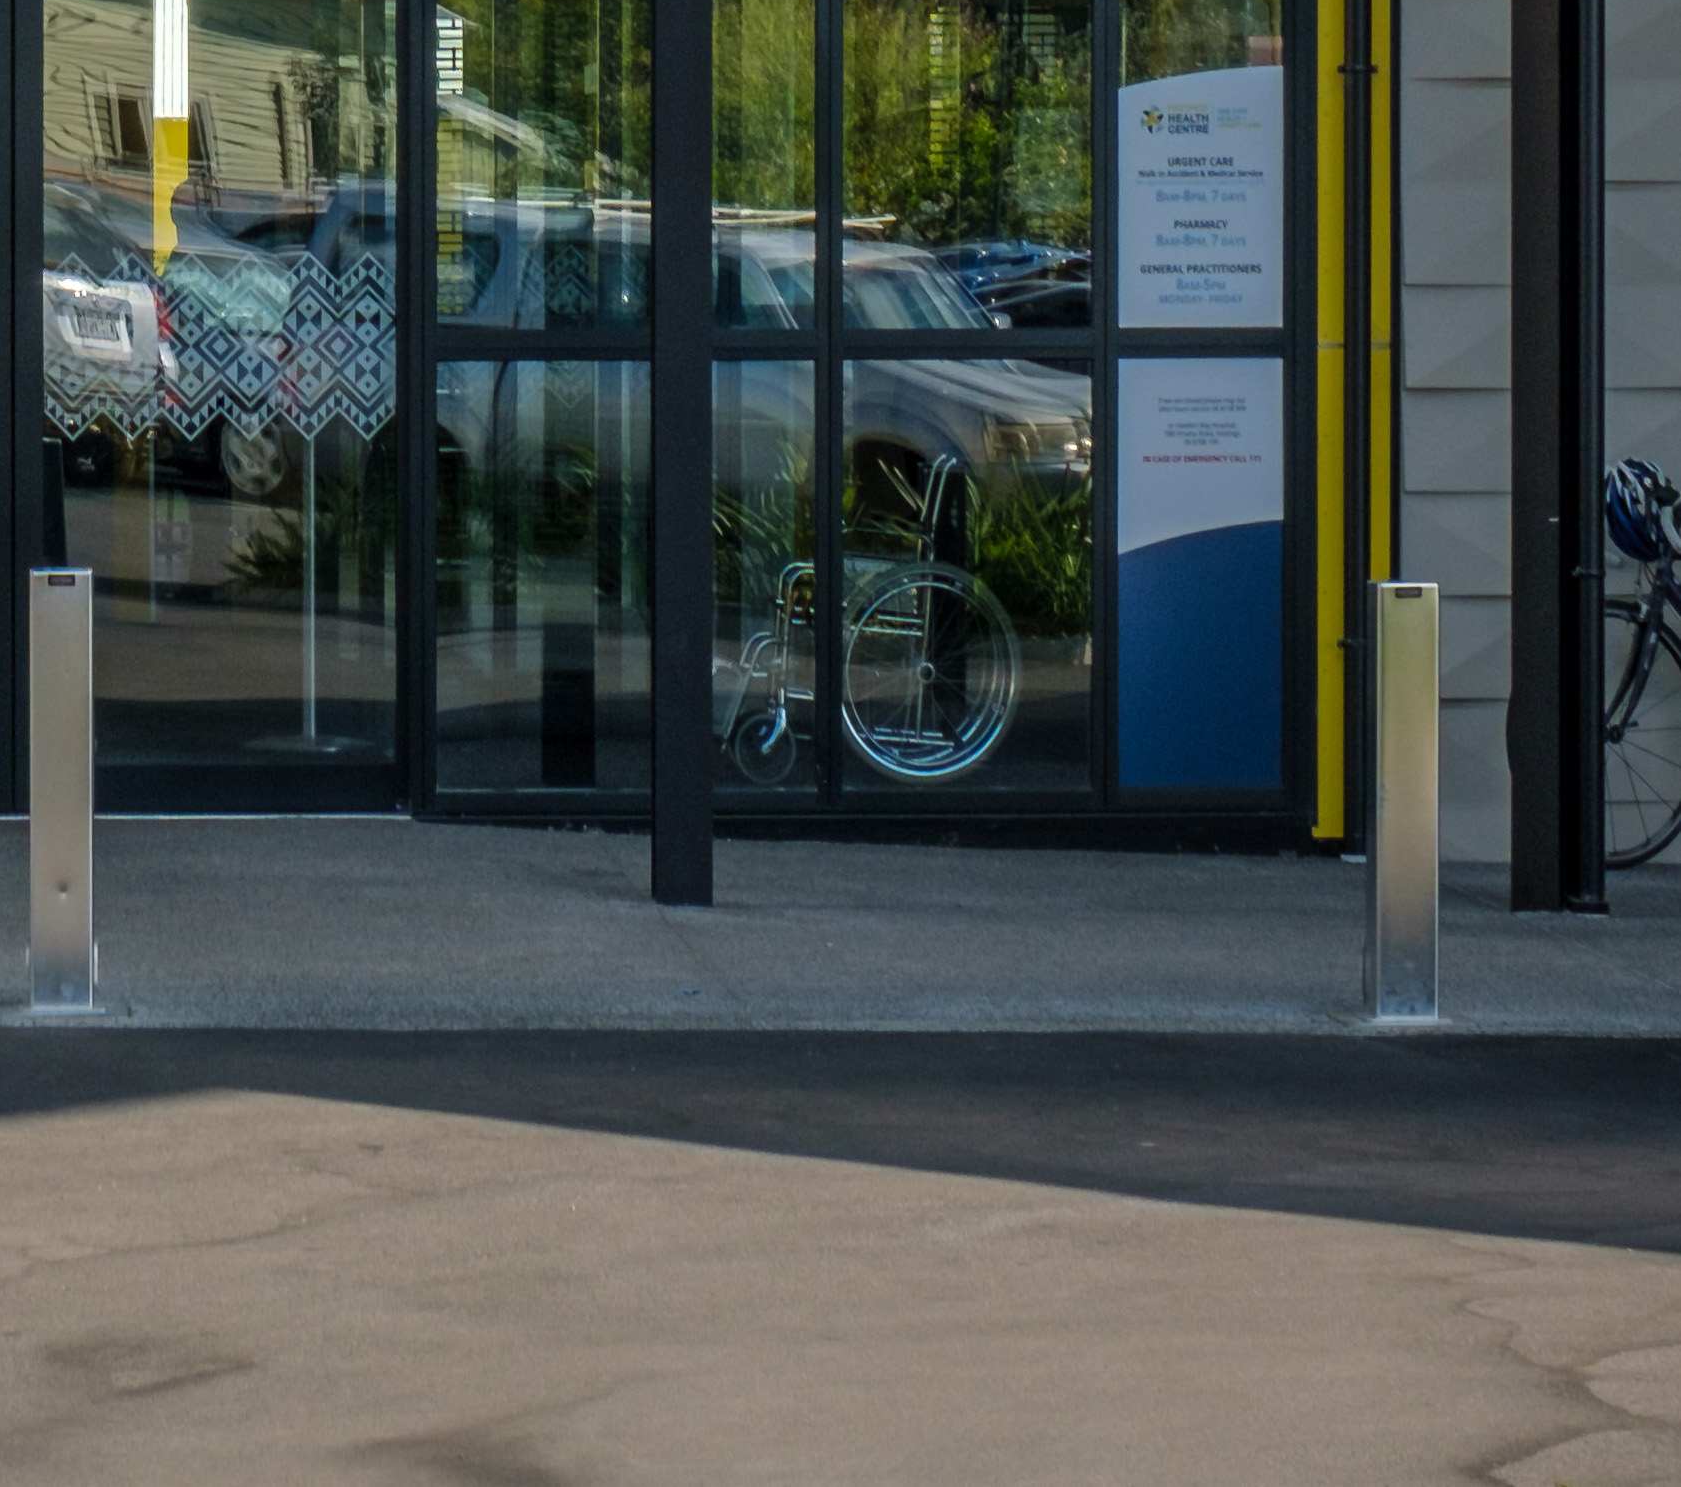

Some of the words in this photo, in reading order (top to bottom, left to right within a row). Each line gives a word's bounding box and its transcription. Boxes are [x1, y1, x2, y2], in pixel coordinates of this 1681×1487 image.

[1167, 113, 1210, 123] HEALTH
[1167, 124, 1210, 135] CENTRE
[1167, 156, 1207, 167] URGENT
[1209, 156, 1234, 167] CARE
[1173, 219, 1228, 229] PHARMACY
[1140, 264, 1185, 275] GENERAL
[1186, 264, 1263, 275] PRACTITIONERS
[1208, 294, 1244, 304] FRIDAY
